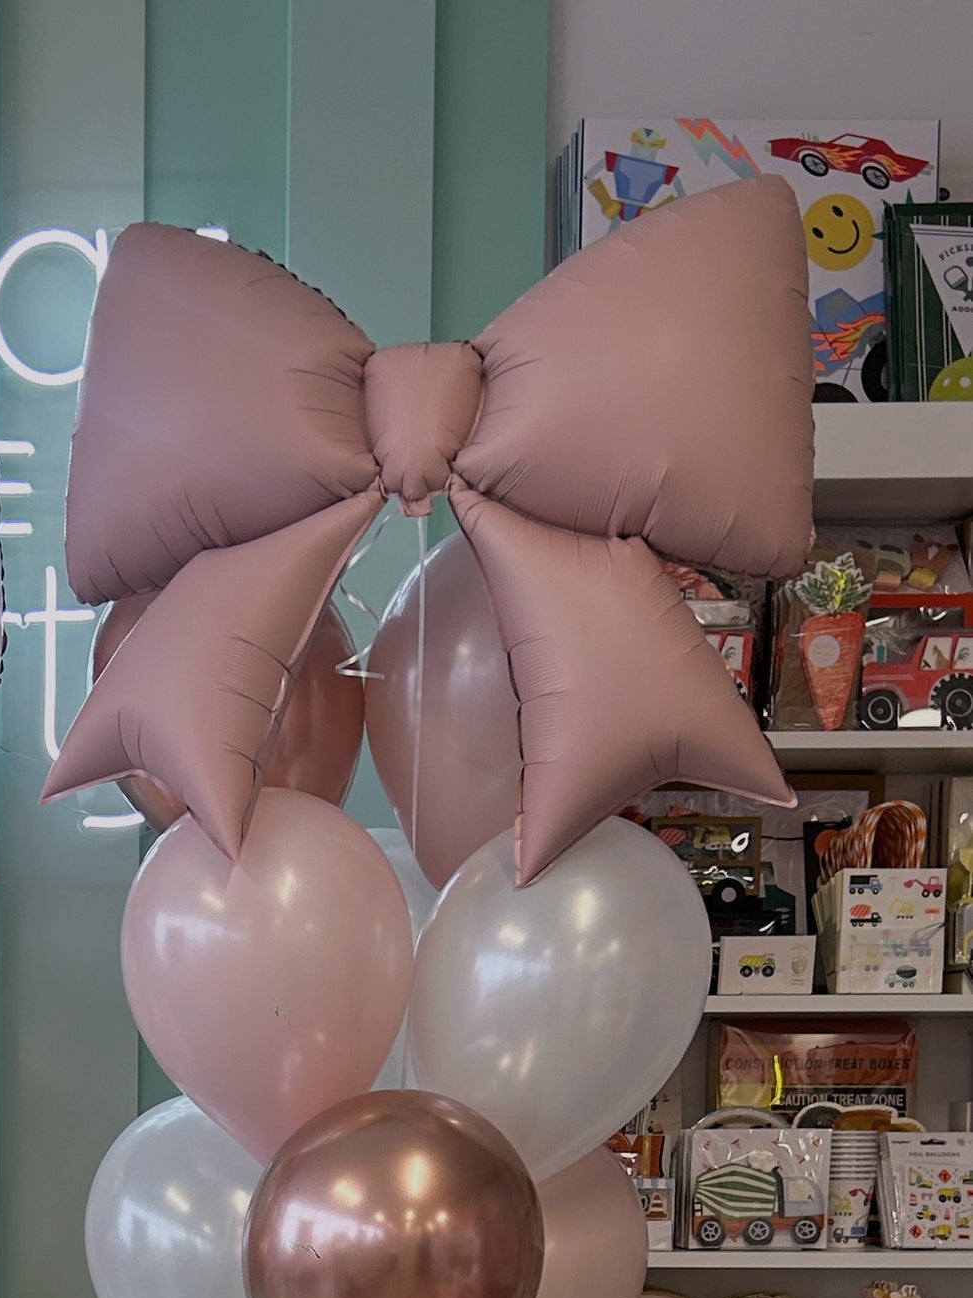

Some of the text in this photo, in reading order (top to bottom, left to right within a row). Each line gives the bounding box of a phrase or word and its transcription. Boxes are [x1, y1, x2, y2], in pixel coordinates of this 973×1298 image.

[828, 1057, 864, 1069] TREAT
[869, 1057, 911, 1070] BOXES
[832, 1093, 870, 1106] TREAT
[871, 1093, 905, 1106] ZONE
